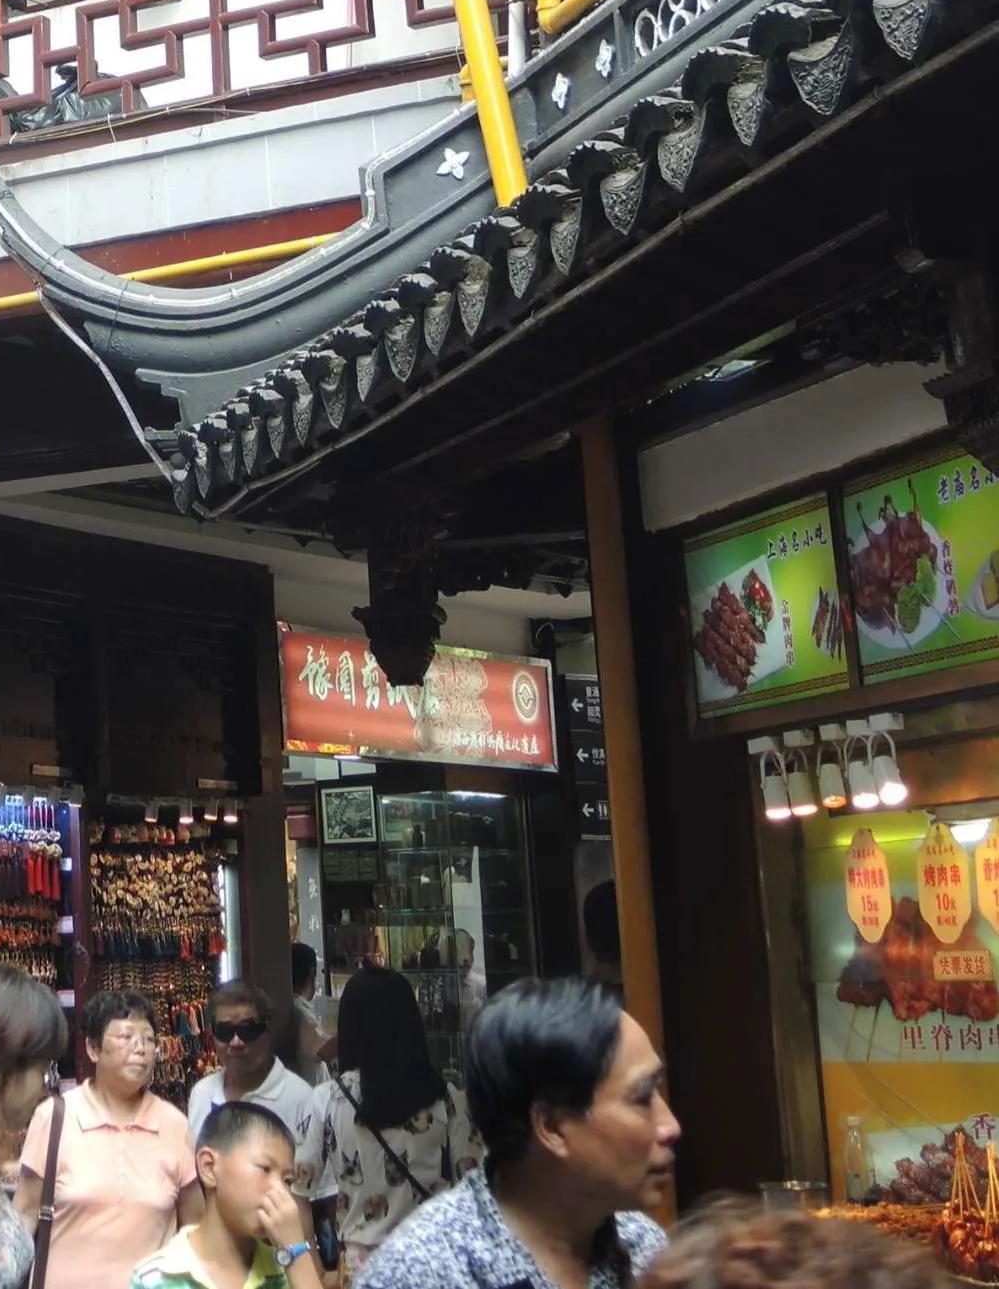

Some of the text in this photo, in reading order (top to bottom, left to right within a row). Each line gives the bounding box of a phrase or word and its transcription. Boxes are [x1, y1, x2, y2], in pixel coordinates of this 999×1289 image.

[924, 864, 961, 887] 烤肉串
[939, 956, 985, 975] 凭票发货
